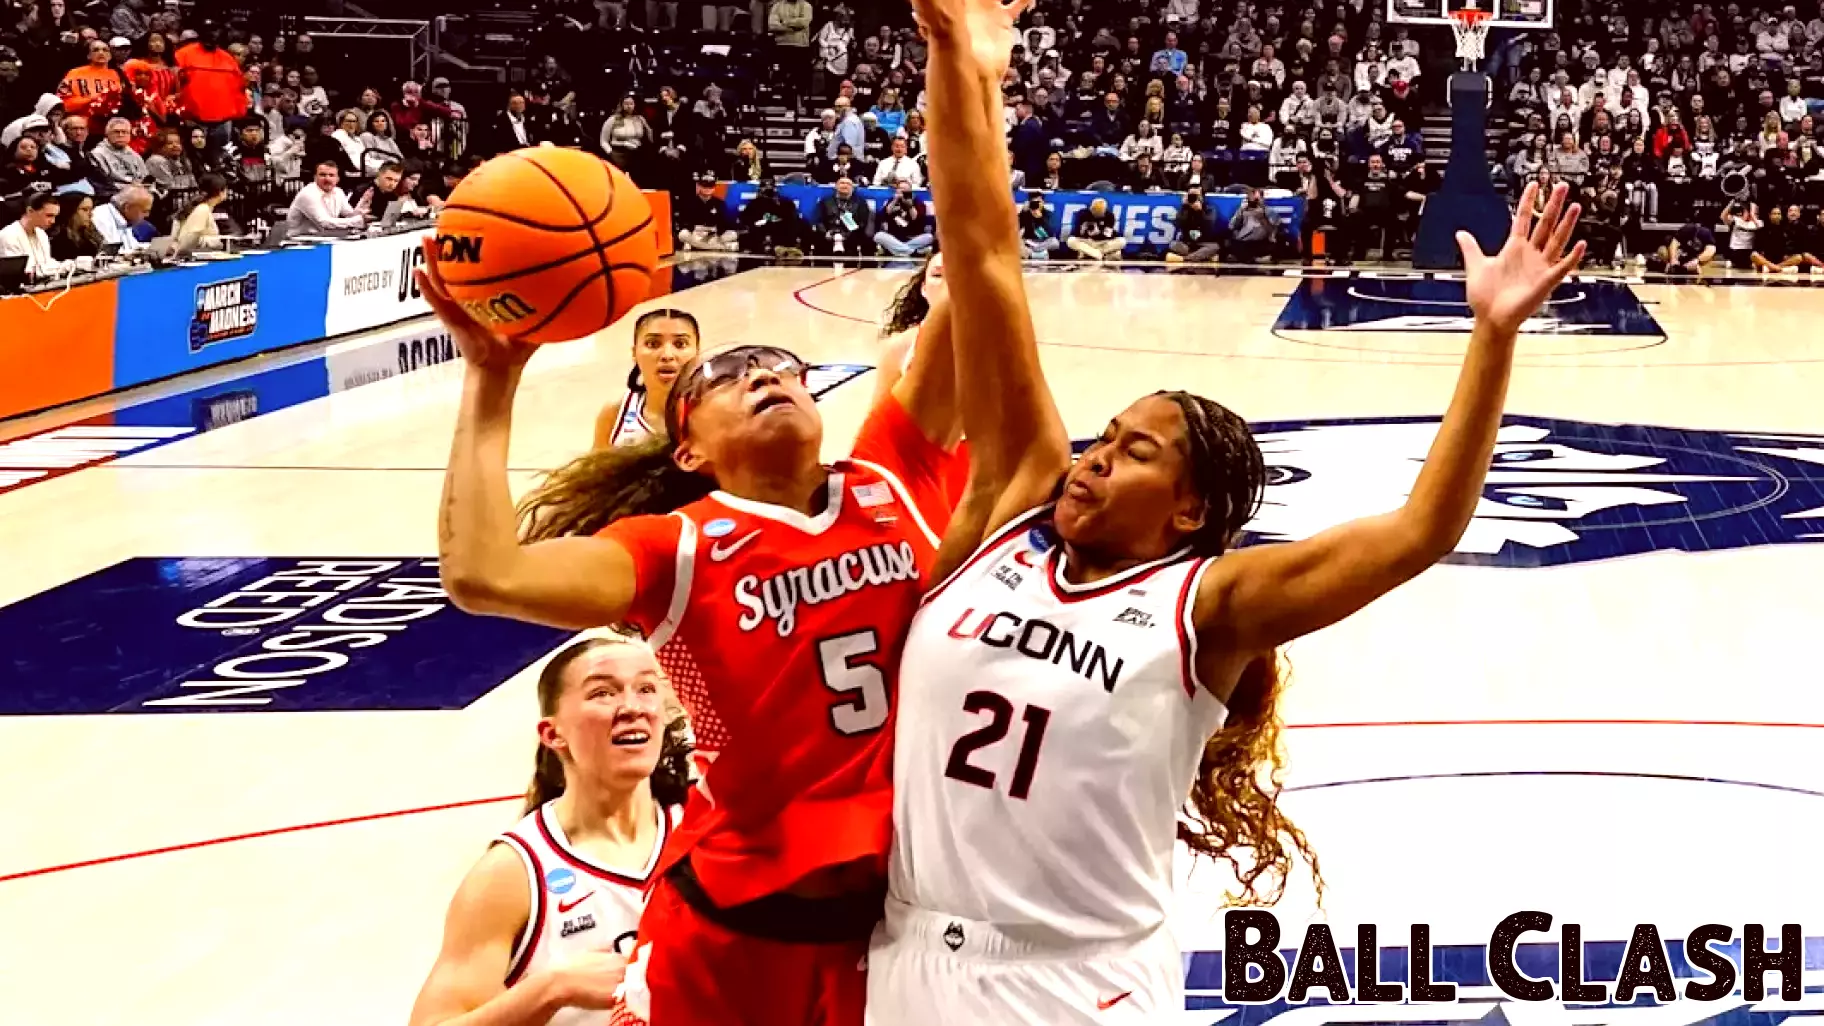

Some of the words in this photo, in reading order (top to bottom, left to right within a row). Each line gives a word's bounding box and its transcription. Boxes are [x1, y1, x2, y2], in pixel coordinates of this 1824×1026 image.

[344, 271, 380, 296] HOSTED
[382, 270, 394, 289] BY
[734, 540, 920, 638] Syracuse
[817, 629, 890, 736] 5
[947, 608, 1124, 693] UCONN
[944, 690, 1051, 800] 21
